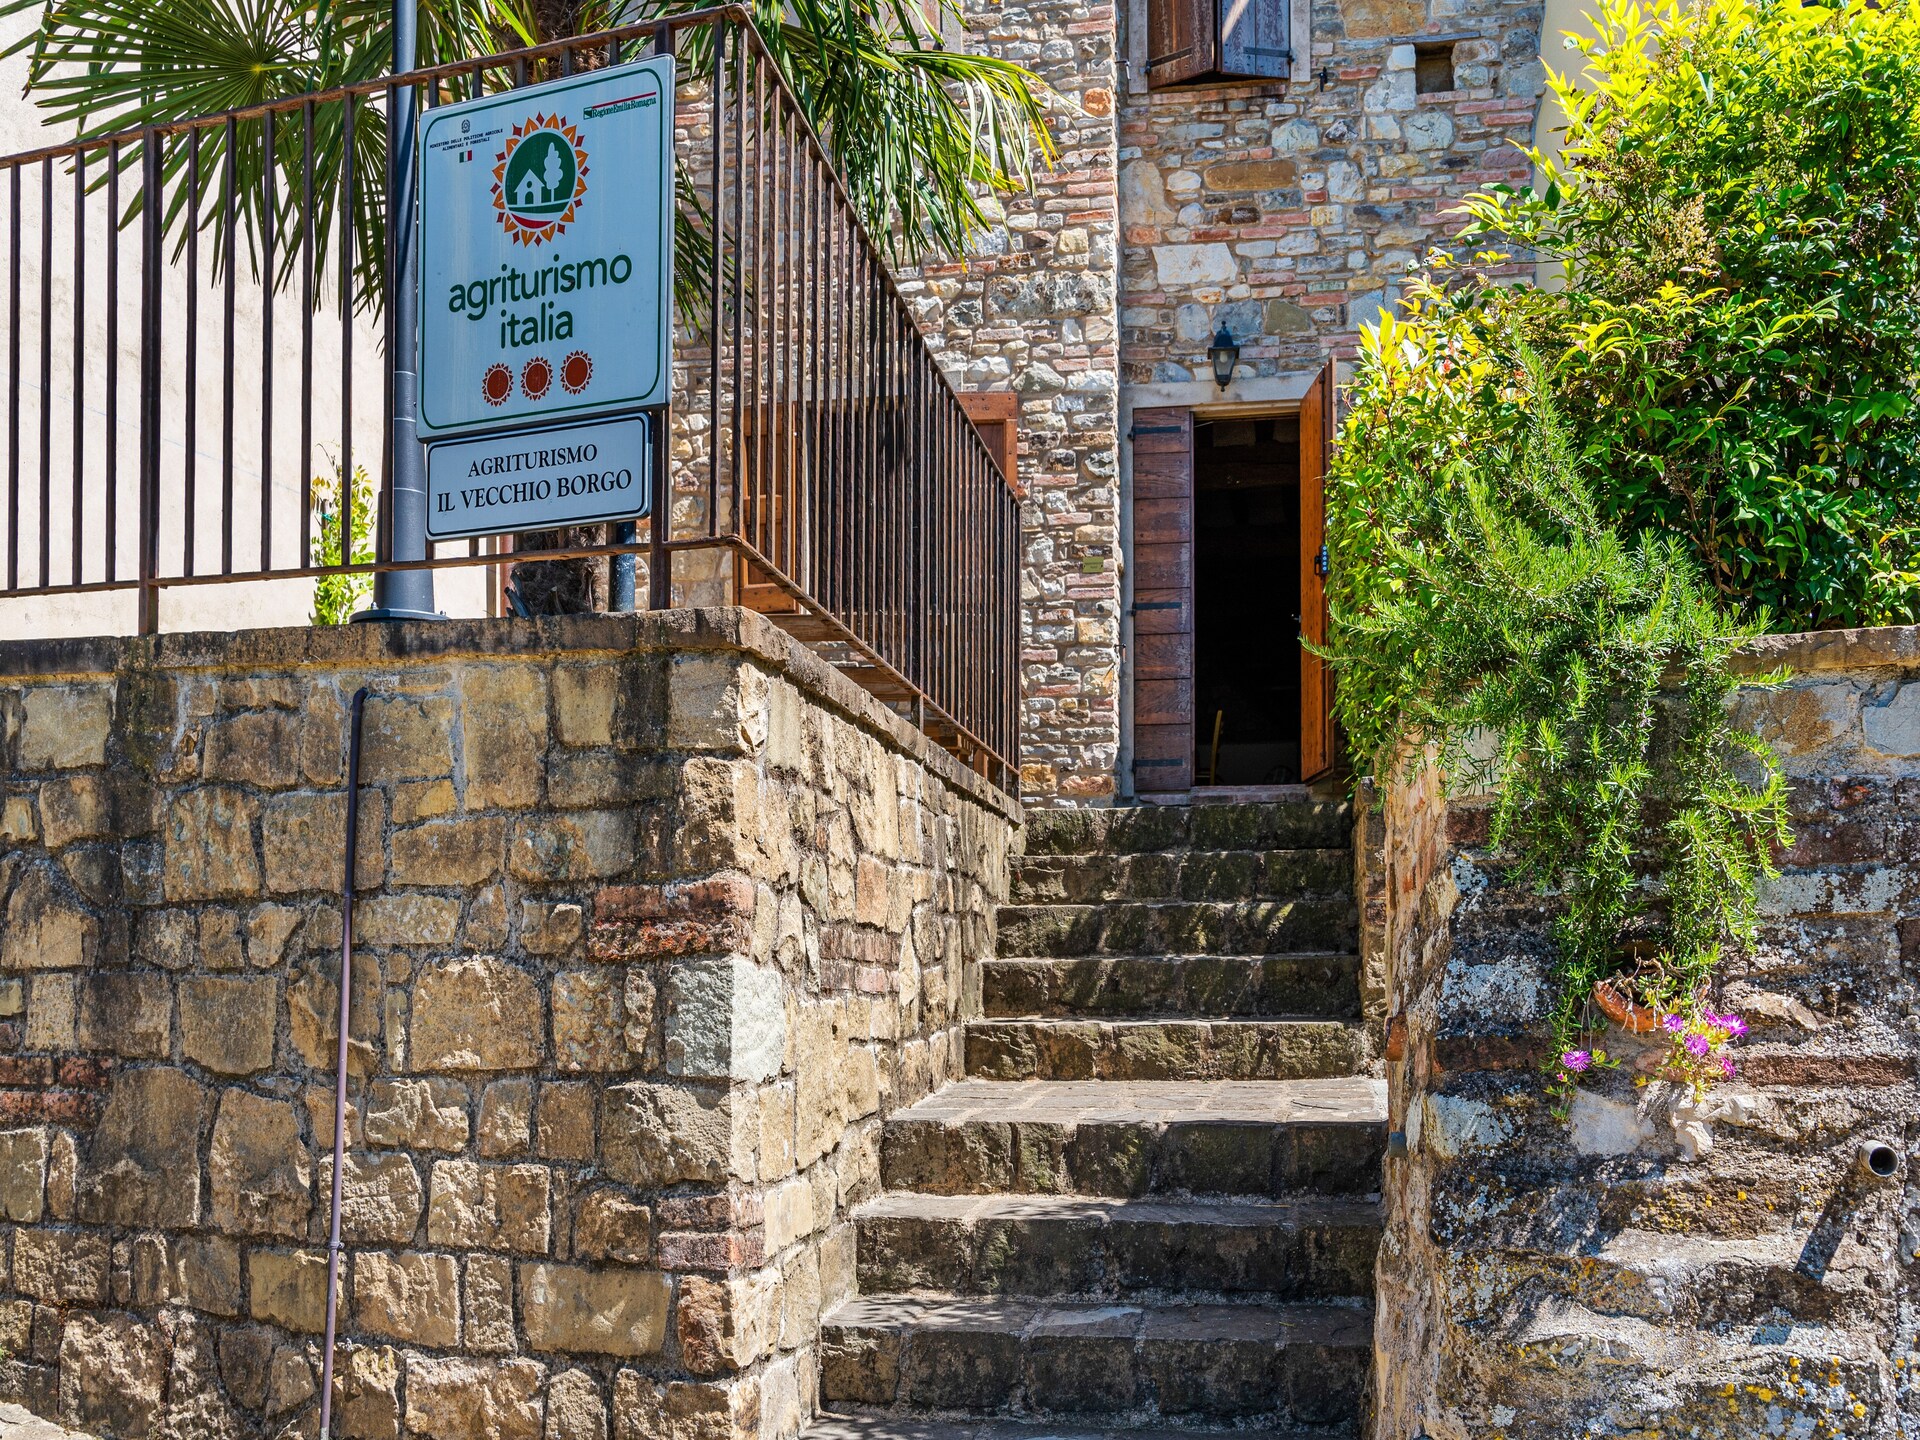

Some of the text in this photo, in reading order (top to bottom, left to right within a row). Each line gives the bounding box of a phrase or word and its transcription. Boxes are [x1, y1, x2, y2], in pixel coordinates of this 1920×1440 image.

[442, 143, 464, 151] ALIMENTARI
[470, 137, 490, 145] FORESTALI
[463, 132, 483, 141] POLITICHE
[485, 128, 503, 137] AGRICOLE
[449, 254, 632, 321] agriturismo
[501, 301, 573, 349] italia
[468, 444, 598, 478] AGRITURISMO
[437, 469, 632, 513] IL VECCHIO BORGO
